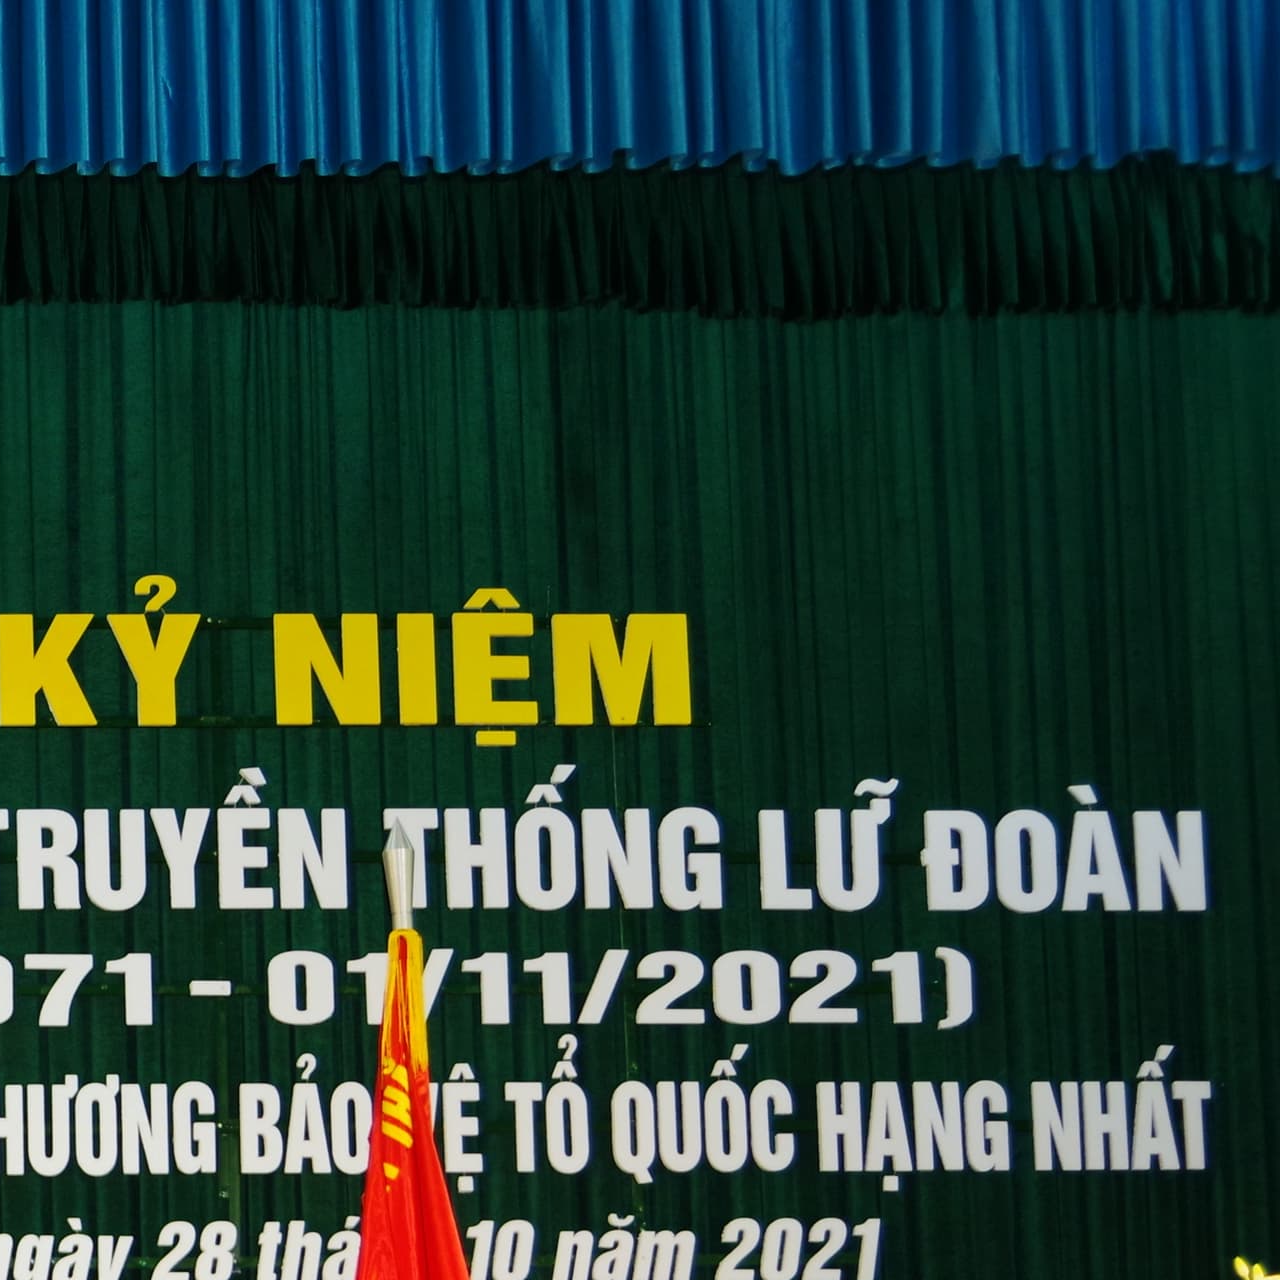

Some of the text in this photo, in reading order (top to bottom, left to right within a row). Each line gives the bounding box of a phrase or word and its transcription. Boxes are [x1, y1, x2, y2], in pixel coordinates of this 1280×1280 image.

[274, 588, 691, 746] NIỆM
[383, 765, 723, 911] THỐNG
[759, 779, 898, 911] LỮ
[921, 785, 1206, 912] ĐOÀN
[189, 980, 231, 996] -
[268, 947, 972, 1030] 01/11/2021)
[240, 1054, 371, 1175] BẢO
[505, 1034, 590, 1174] TỔ
[611, 1044, 795, 1183] QUỐC
[817, 1081, 1010, 1192] HẠNG
[1032, 1044, 1211, 1171] NHẤT
